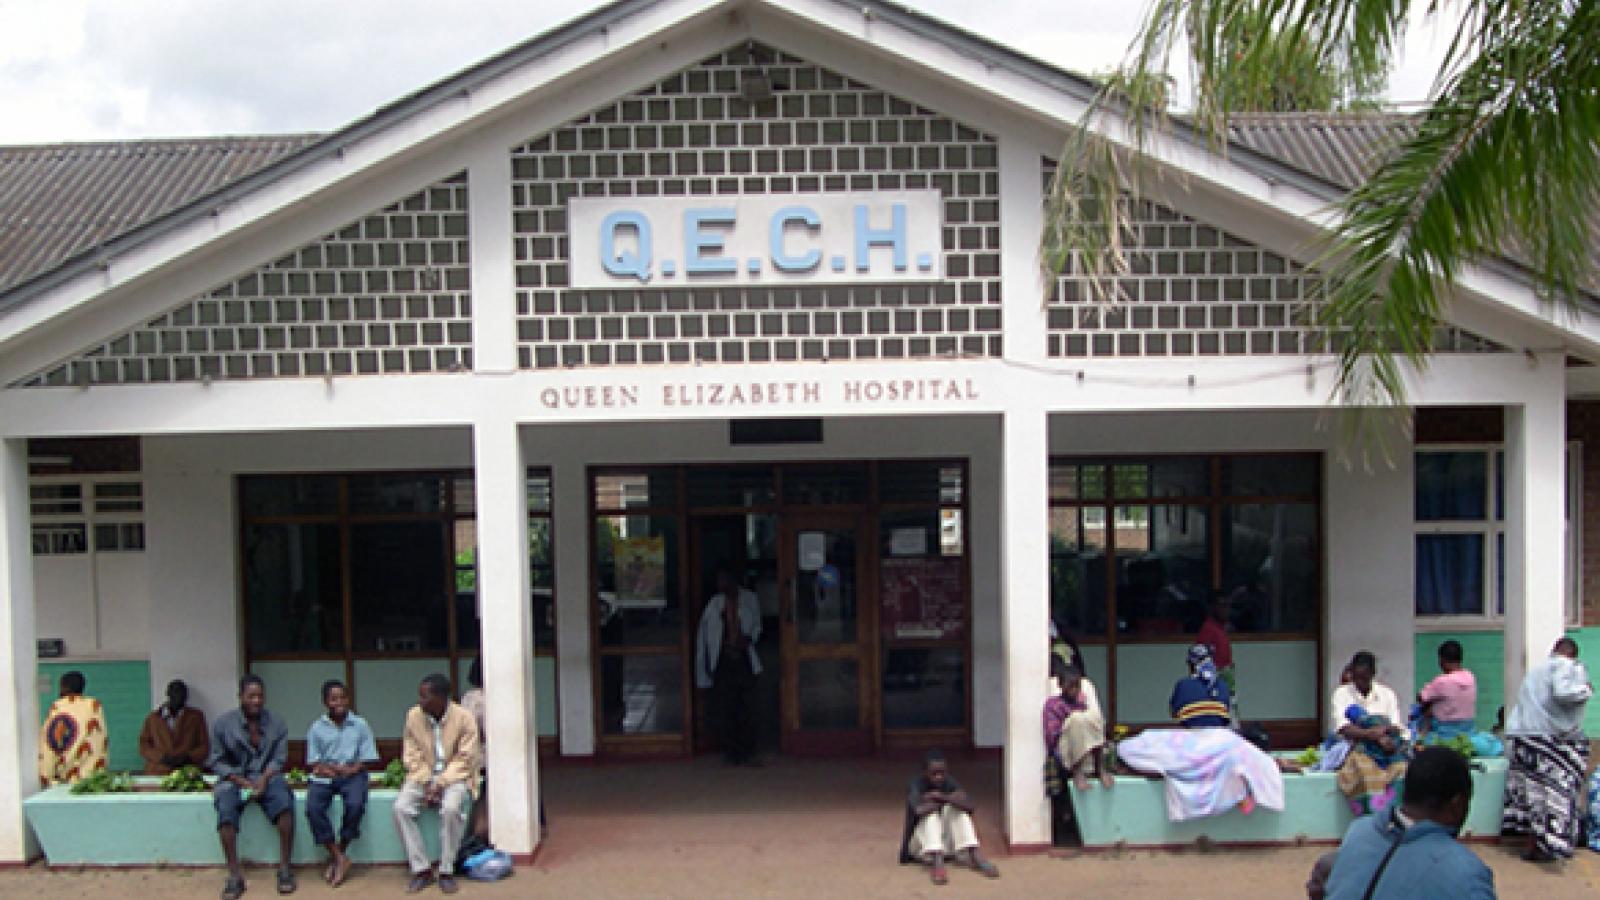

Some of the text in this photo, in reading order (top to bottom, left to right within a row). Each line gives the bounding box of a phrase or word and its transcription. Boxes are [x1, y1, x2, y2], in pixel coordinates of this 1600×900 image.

[600, 203, 933, 282] Q.E.C.H.
[540, 379, 980, 408] QUEEN ELIZABETH HOSPITAL
